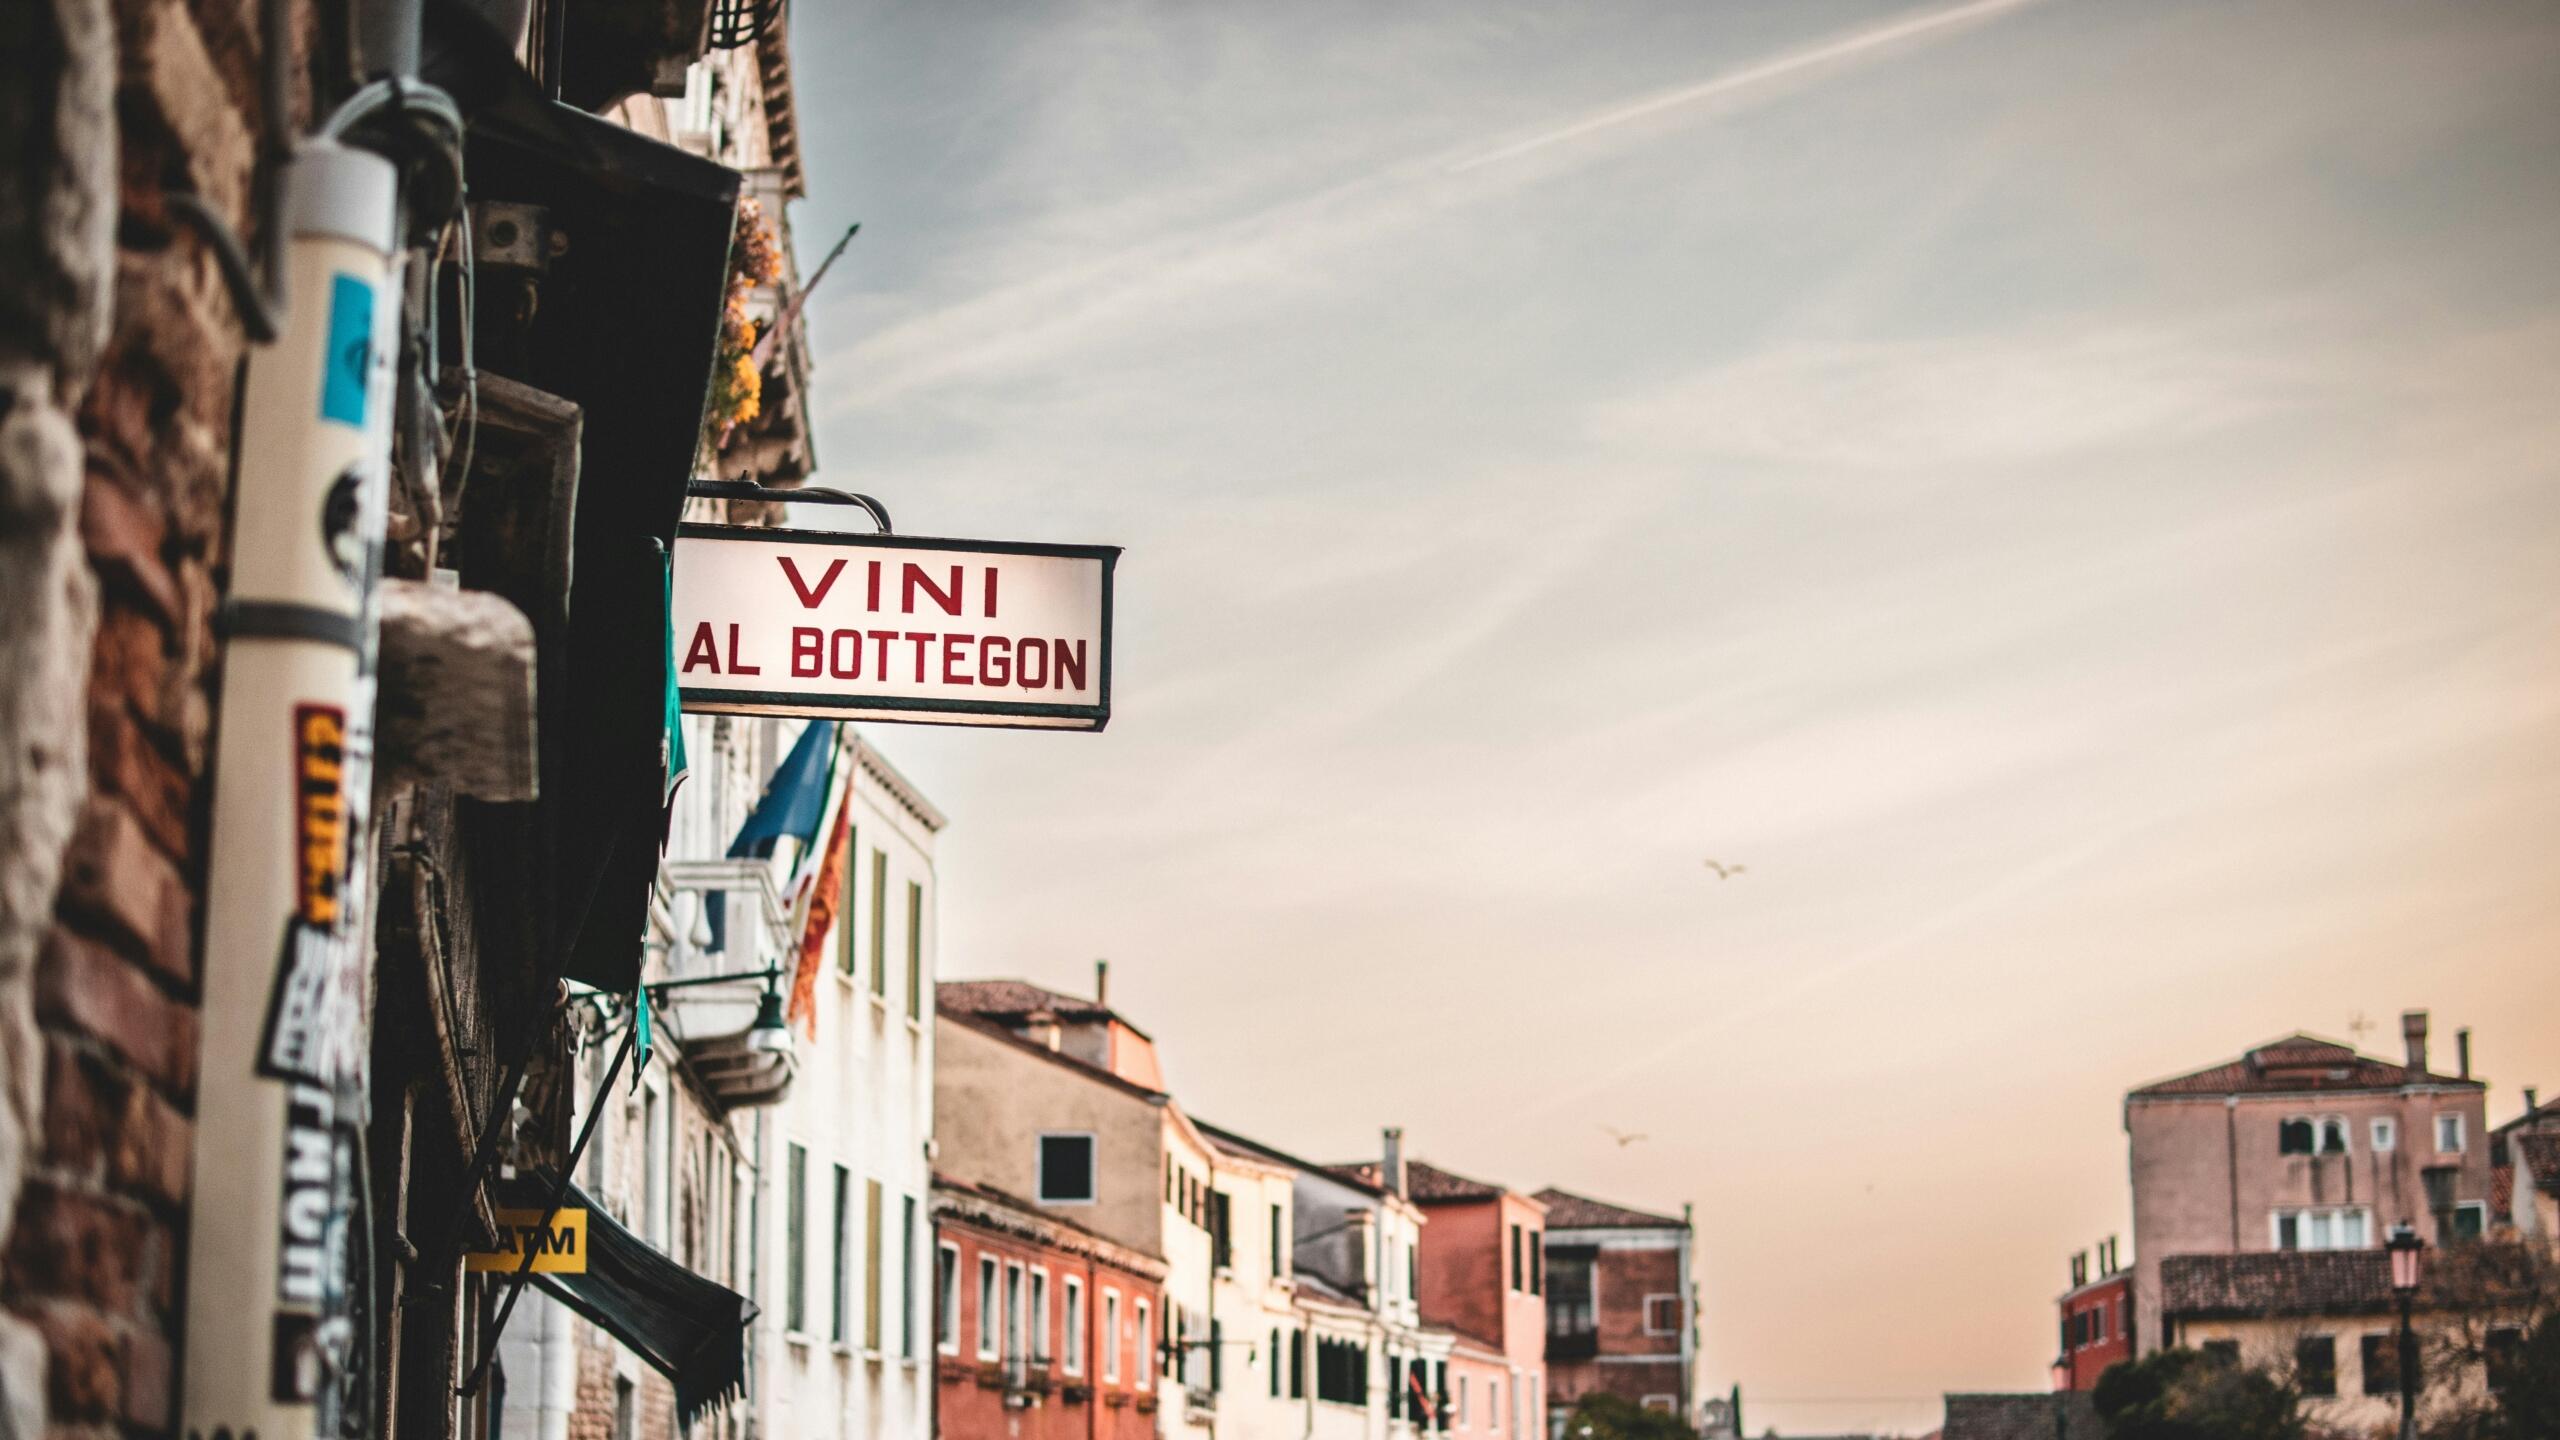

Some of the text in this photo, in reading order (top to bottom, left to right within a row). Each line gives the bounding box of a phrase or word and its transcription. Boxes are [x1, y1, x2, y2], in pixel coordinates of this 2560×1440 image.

[777, 556, 998, 618] VINI
[682, 622, 1087, 690] AL BOTTEGON
[496, 1225, 576, 1255] ATM
